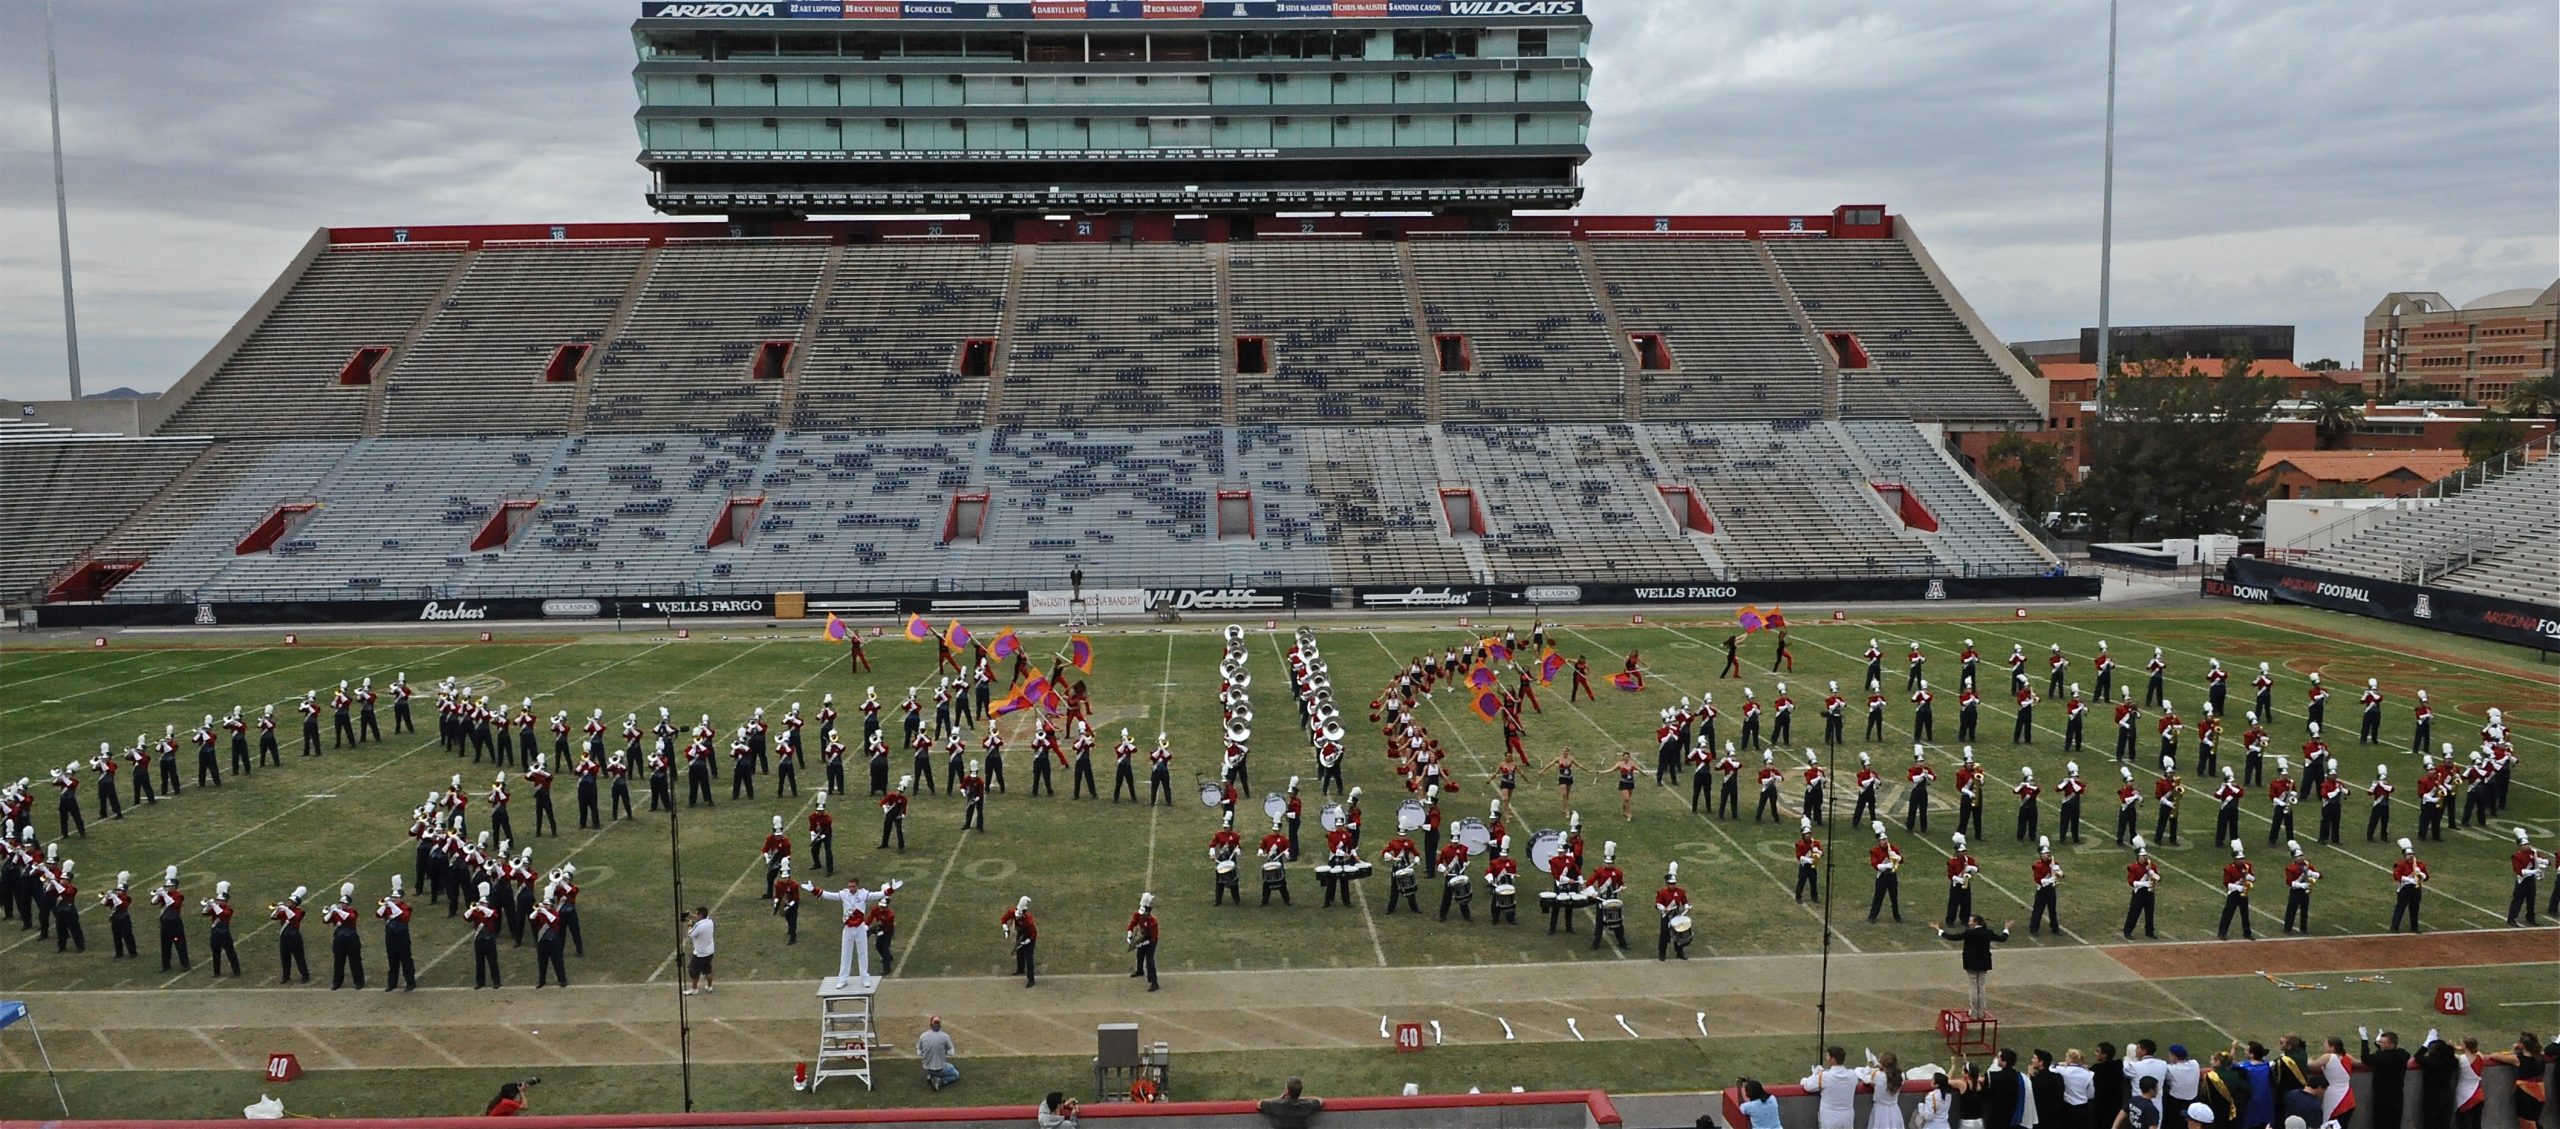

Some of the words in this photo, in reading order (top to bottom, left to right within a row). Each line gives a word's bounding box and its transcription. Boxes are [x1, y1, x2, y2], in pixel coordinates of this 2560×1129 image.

[656, 4, 775, 17] ARIZONA
[1450, 2, 1576, 14] WILDCATS
[929, 227, 942, 236] 20
[1079, 226, 1090, 234] 21
[1302, 224, 1313, 233] 22
[1497, 223, 1510, 232] 23
[1656, 222, 1668, 232] 24
[1790, 222, 1802, 231] 25
[396, 234, 406, 243] 17
[552, 231, 564, 240] 18
[731, 229, 741, 237] 19
[24, 406, 34, 415] 16
[1634, 588, 1685, 598] WELLS
[1688, 587, 1736, 598] FARGO
[1926, 580, 1946, 599] A
[656, 602, 708, 612] WELLS
[712, 600, 762, 611] FARGO
[1032, 597, 1066, 607] UNIVERSITY
[1109, 596, 1126, 605] BAND
[1128, 596, 1140, 605] DAY
[2414, 594, 2431, 618] A
[195, 604, 216, 624] A
[420, 602, 487, 620] Bashas'
[2443, 990, 2464, 1010] 20
[1400, 1028, 1418, 1048] 40
[268, 1057, 288, 1078] 40
